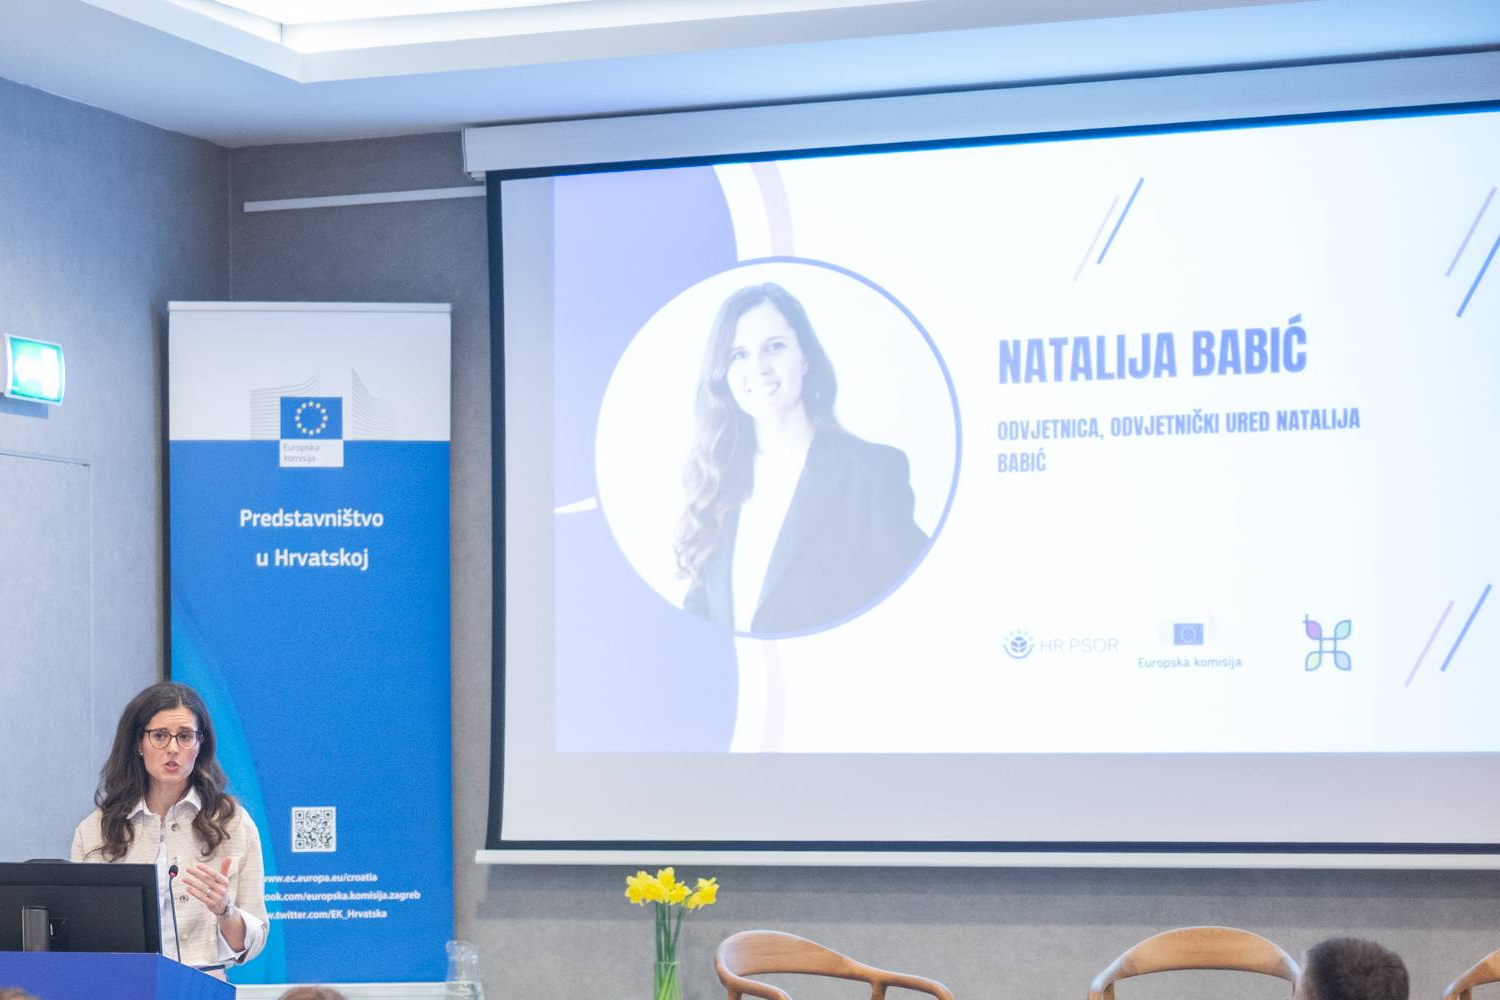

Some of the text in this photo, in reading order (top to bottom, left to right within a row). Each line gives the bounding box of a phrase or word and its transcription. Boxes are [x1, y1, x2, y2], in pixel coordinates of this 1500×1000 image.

[999, 313, 1307, 385] NATALIJA BABIĆ
[997, 407, 1361, 441] ODVJETNICA, ODVJETNIČKI URED NATALIJA
[283, 442, 320, 452] Europska
[283, 454, 316, 464] komisija
[997, 447, 1047, 473] BABIĆ
[239, 507, 384, 528] Predstavništvo
[255, 547, 369, 573] u Hrvatskoj
[1039, 637, 1119, 654] HR PSOR
[1137, 655, 1243, 670] Europska komisija
[264, 873, 378, 884] ww.ec.europa.eu/croatia
[264, 890, 421, 902] ook.com/europska.komisija.zagreb
[268, 910, 388, 920] w.twitter.com/EK_Hrvatska
